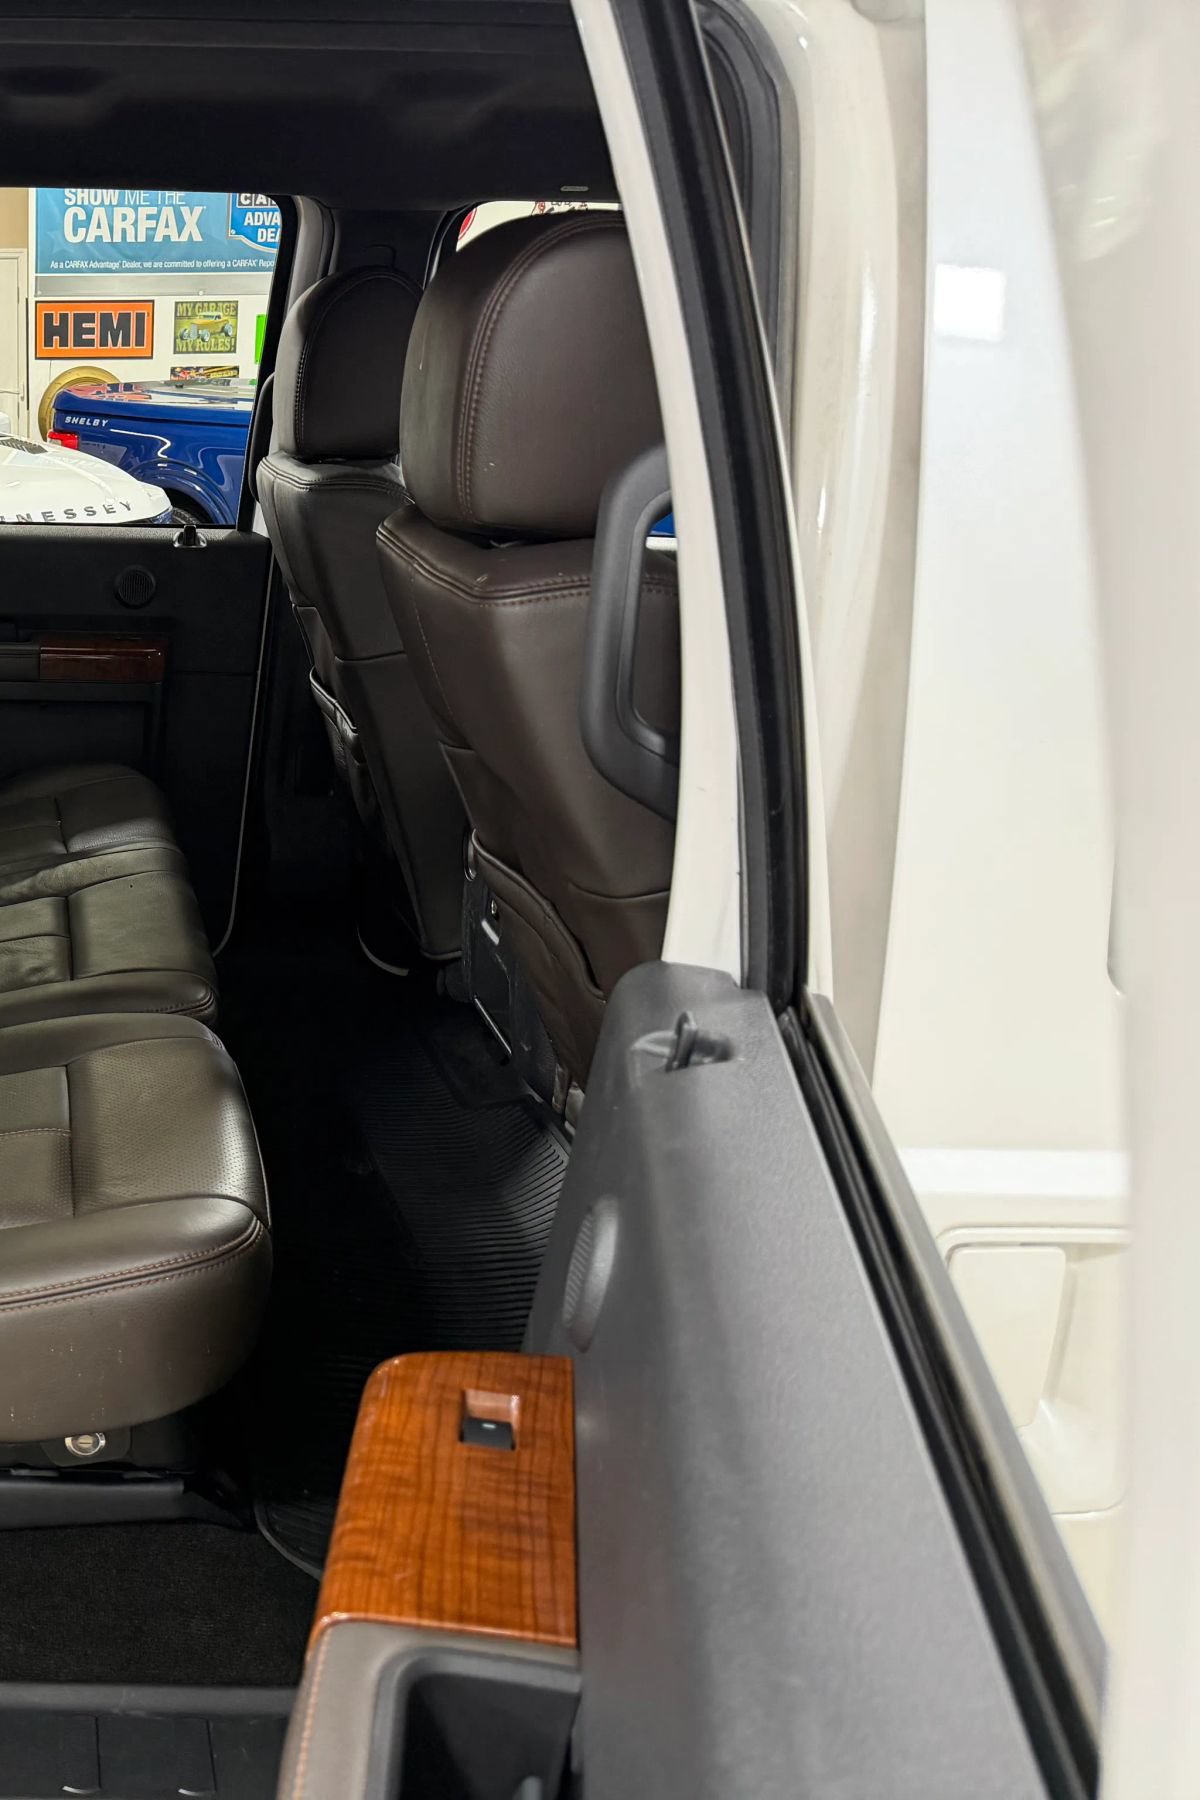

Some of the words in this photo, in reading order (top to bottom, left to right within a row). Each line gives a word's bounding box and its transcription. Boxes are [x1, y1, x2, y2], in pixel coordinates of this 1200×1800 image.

[64, 188, 119, 206] SHOW
[124, 190, 150, 205] ME
[64, 206, 203, 243] CARFAX
[65, 260, 89, 269] CARFAX
[163, 260, 195, 268] committed
[195, 260, 203, 268] to
[232, 259, 257, 268] CARFAX
[177, 303, 193, 316] MY
[195, 302, 237, 316] GARAGE
[42, 311, 147, 349] HEMI
[176, 339, 193, 352] MY
[64, 416, 109, 427] SHELBY
